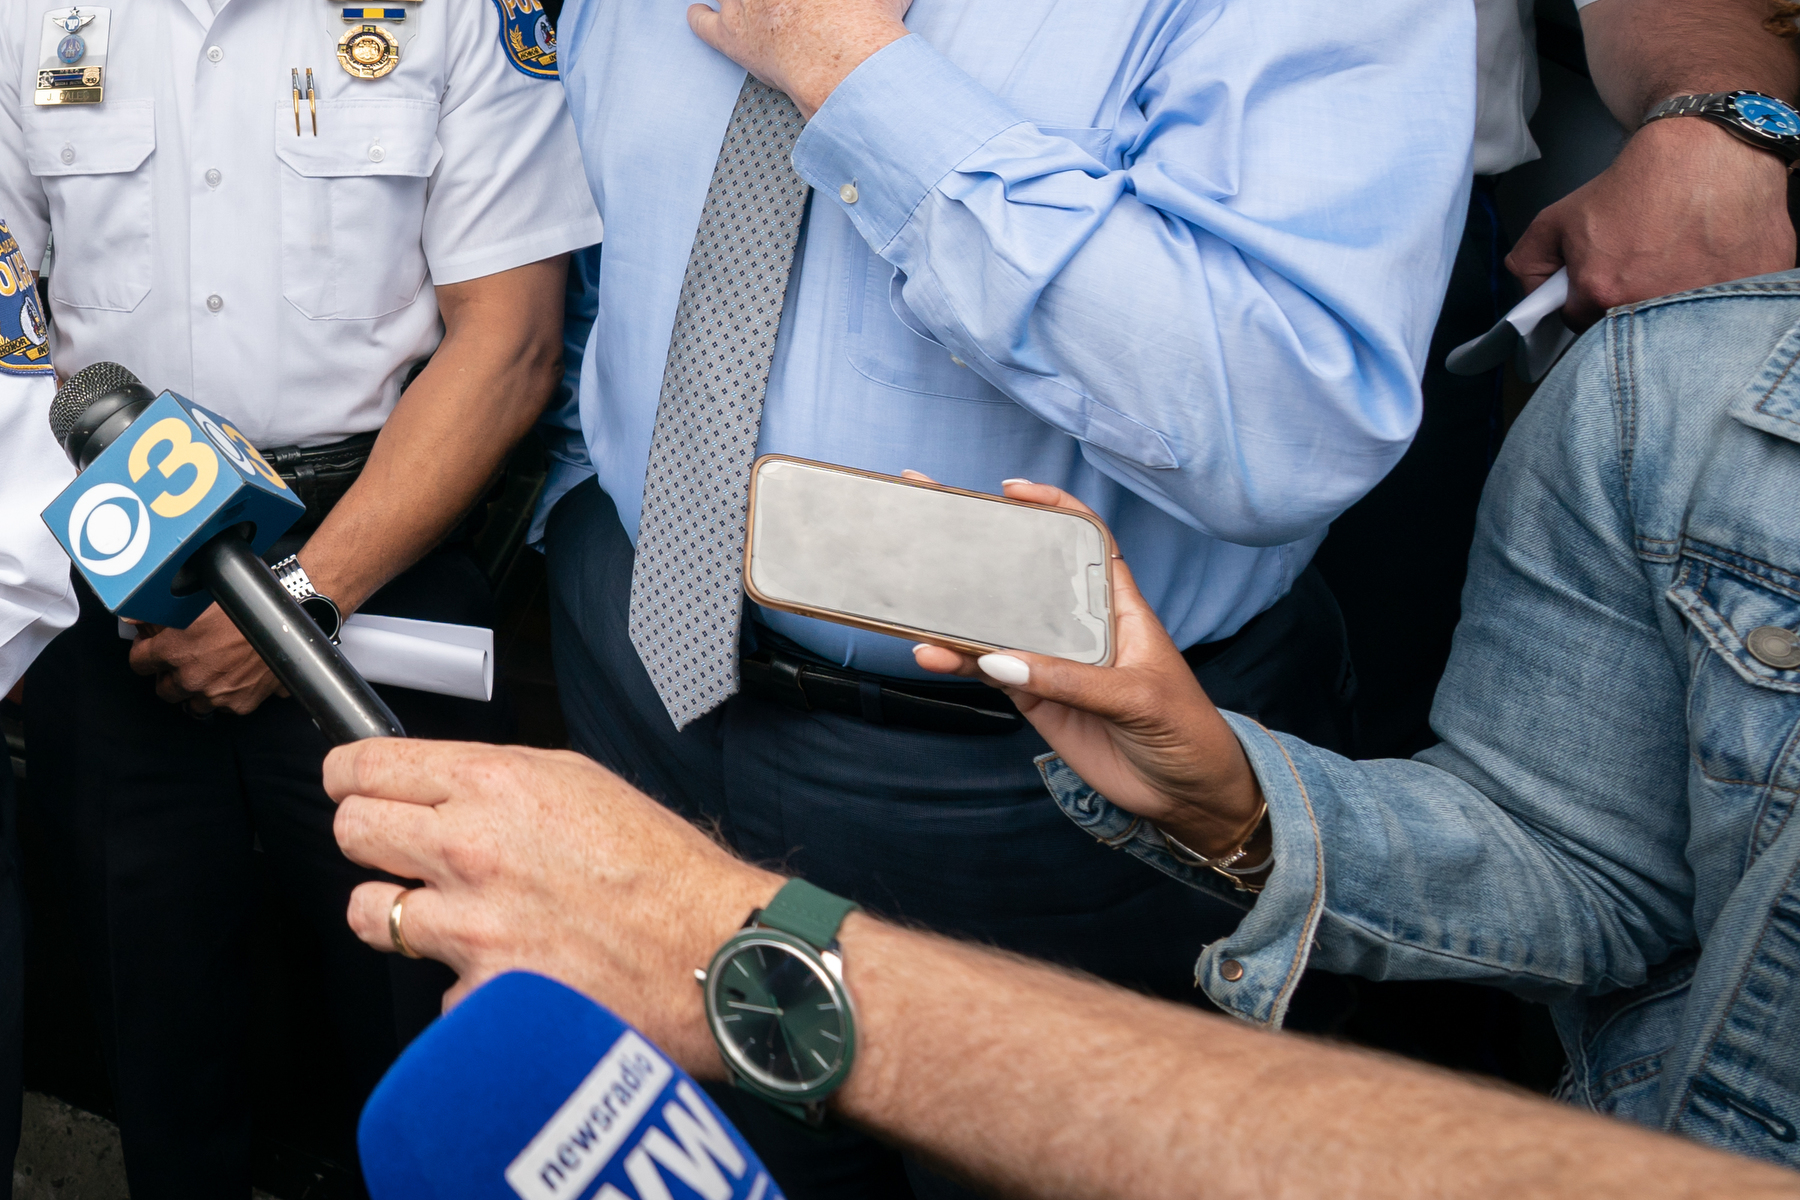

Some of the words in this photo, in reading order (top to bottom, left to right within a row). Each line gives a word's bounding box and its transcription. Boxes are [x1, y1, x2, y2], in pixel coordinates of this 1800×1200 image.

[128, 417, 219, 518] 3
[221, 423, 287, 490] 3
[538, 1052, 655, 1193] newsradio
